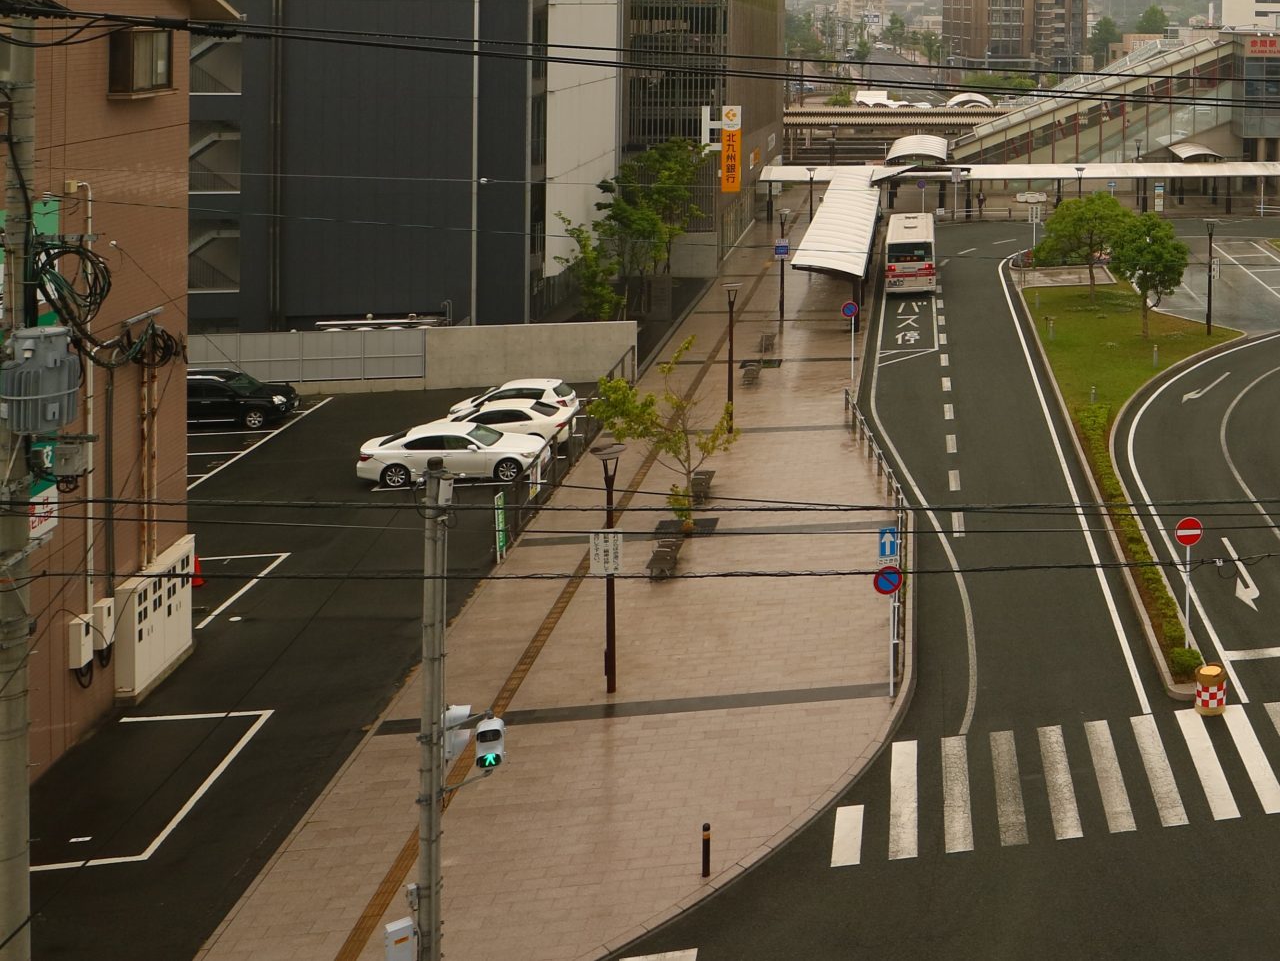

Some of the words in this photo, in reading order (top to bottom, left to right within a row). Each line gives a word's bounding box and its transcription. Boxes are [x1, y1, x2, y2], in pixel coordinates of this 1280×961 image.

[725, 132, 737, 184] 北九州銀行
[895, 301, 928, 345] バス停
